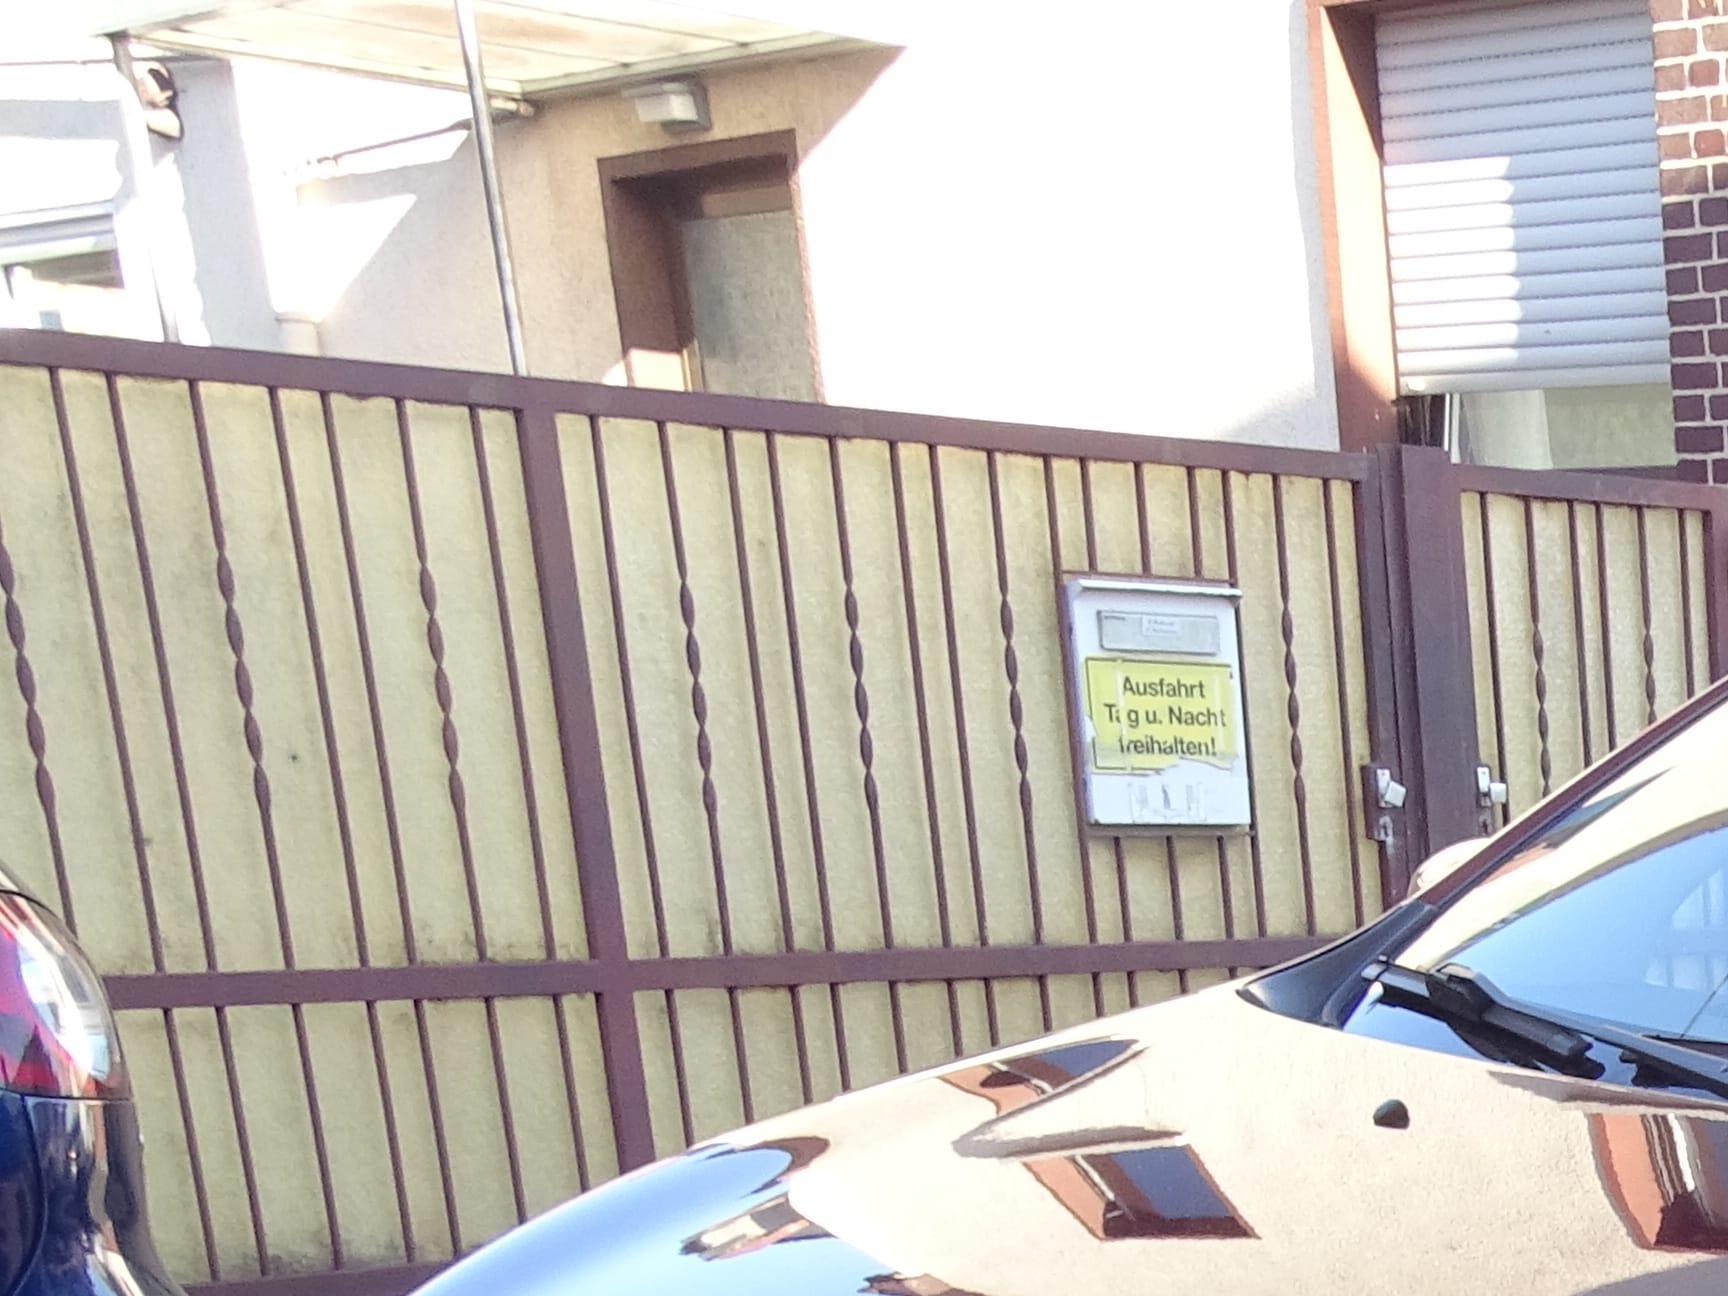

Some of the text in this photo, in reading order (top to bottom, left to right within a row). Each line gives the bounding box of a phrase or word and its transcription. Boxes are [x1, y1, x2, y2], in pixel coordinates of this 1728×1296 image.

[1122, 676, 1206, 699] Ausfahrt
[1145, 710, 1162, 724] u.
[1168, 706, 1226, 727] Nacht
[1118, 735, 1217, 757] freihalten!
